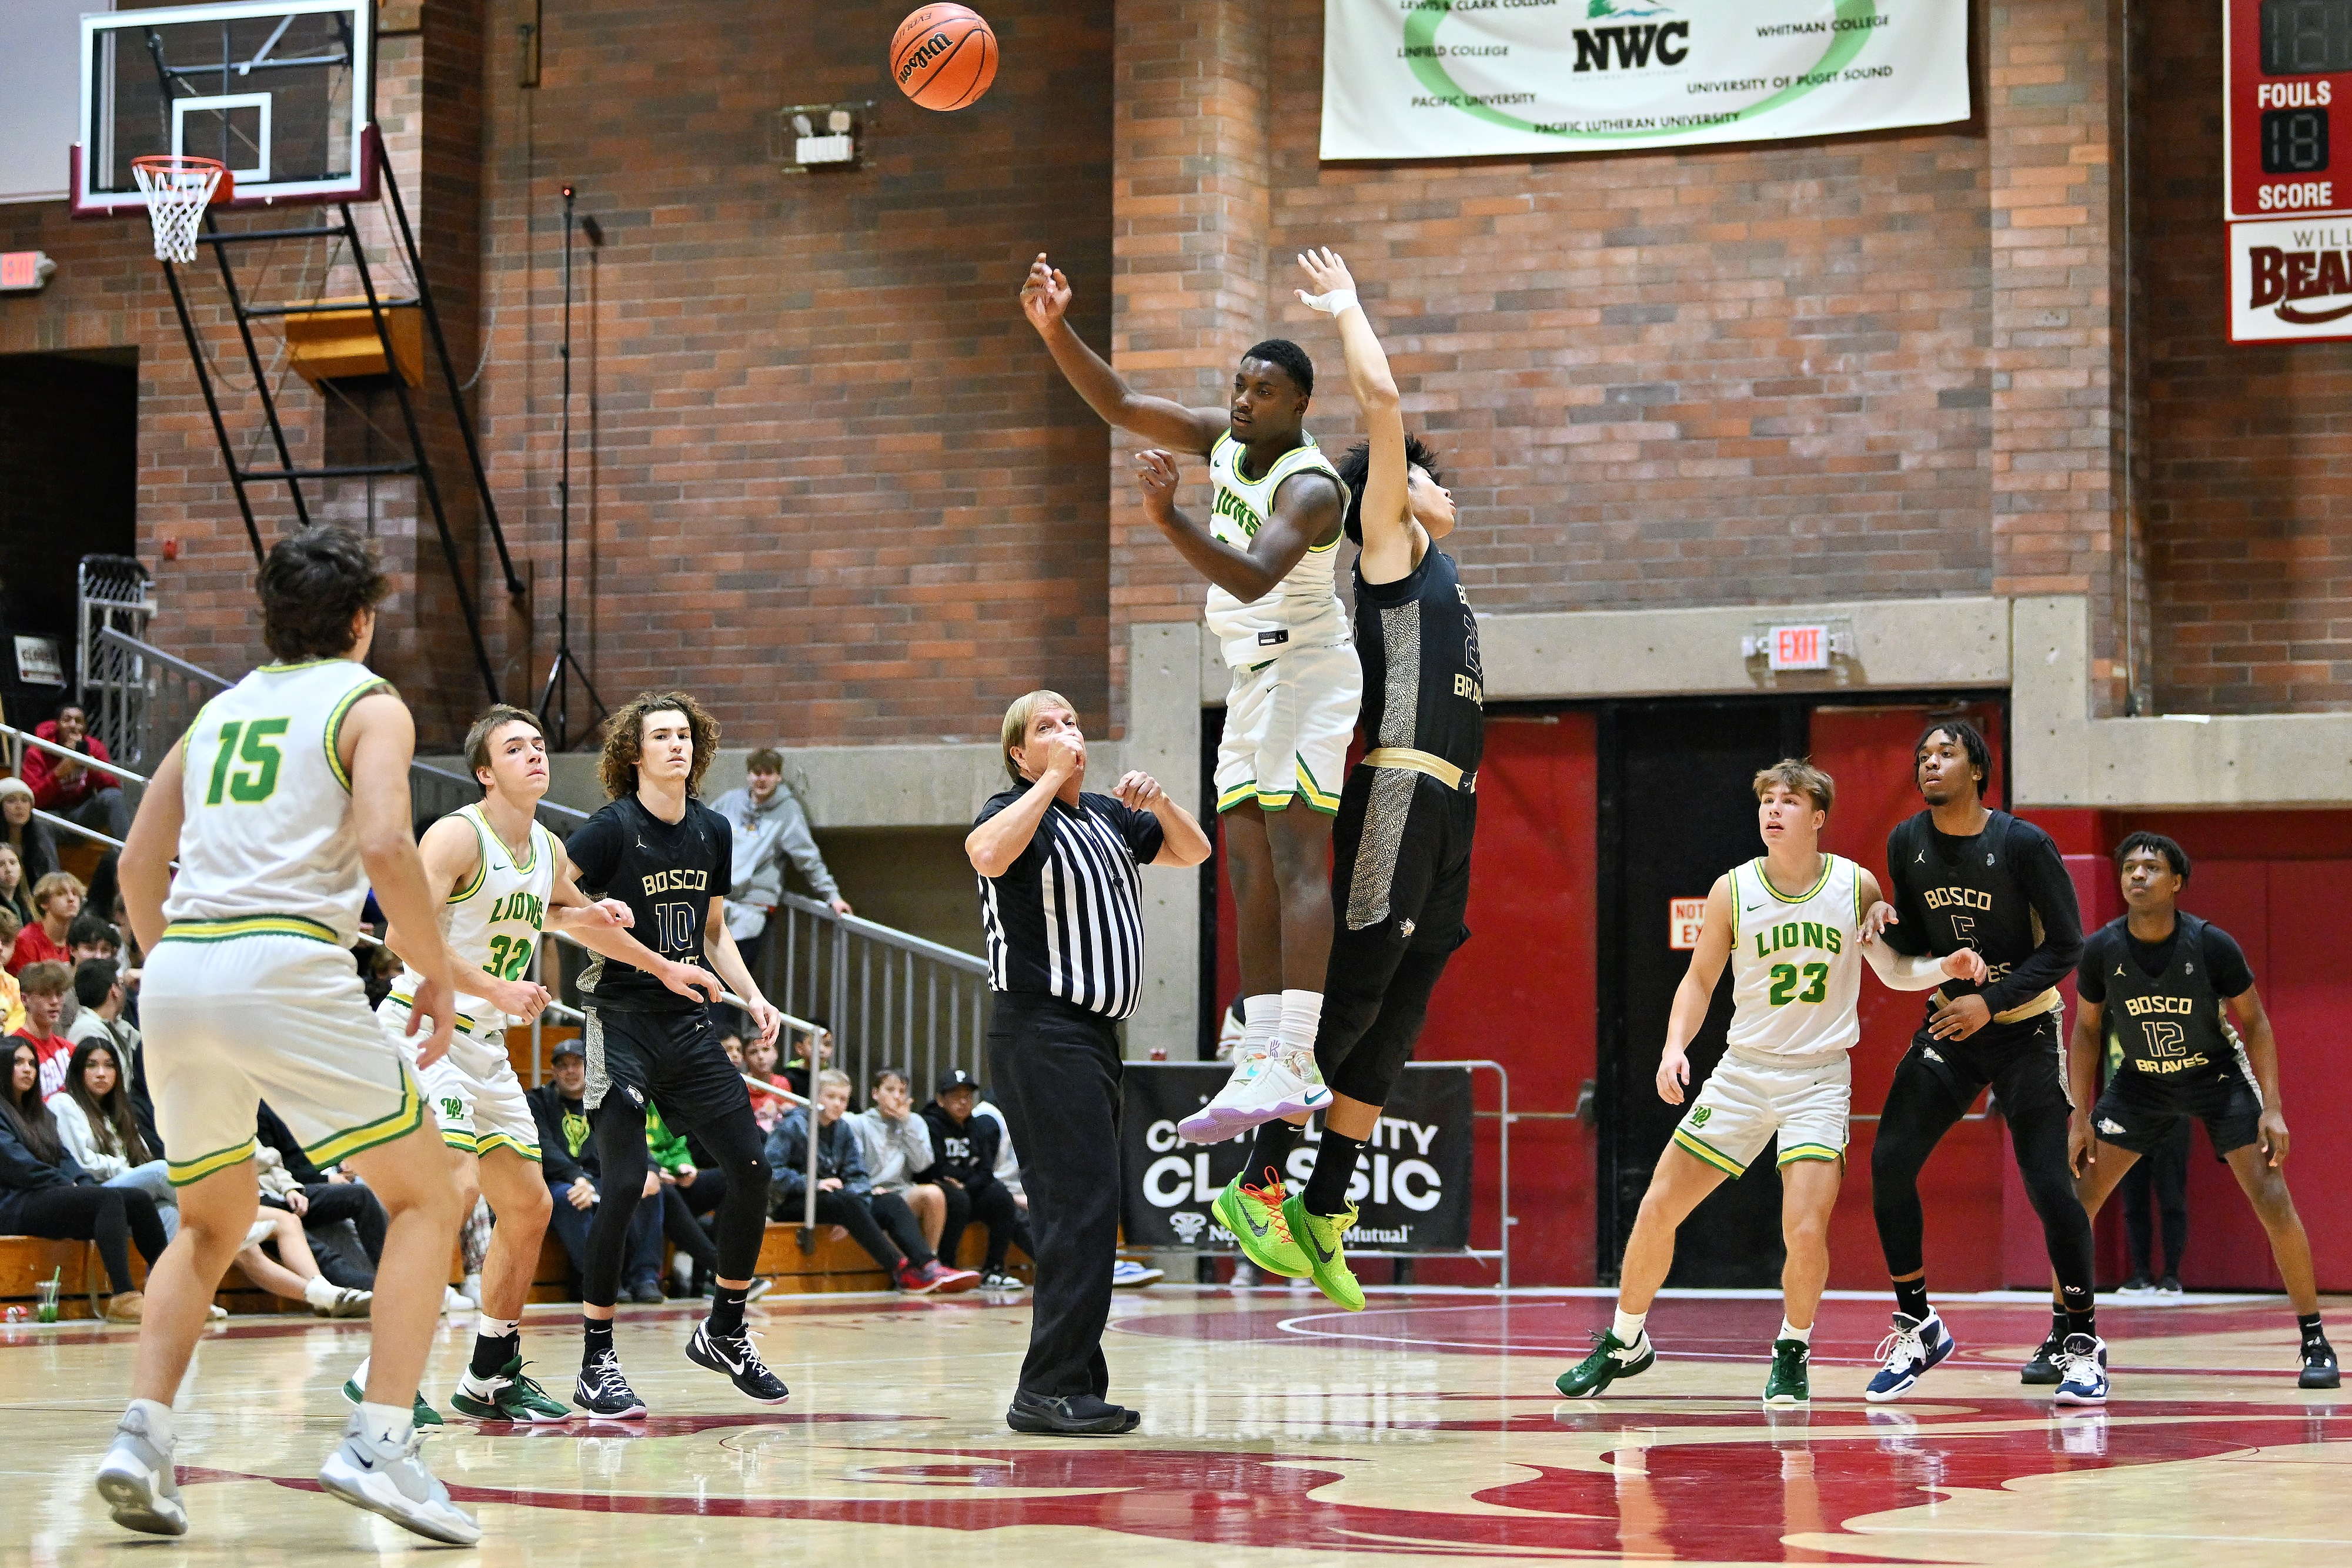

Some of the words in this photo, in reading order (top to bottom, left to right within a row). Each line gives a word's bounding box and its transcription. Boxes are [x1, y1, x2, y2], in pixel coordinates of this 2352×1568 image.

[1456, 0, 1498, 11] CLARK
[1756, 21, 1825, 37] WHITMAN
[1830, 15, 1889, 30] COLLEGE
[898, 32, 954, 84] Wilson
[1396, 45, 1447, 58] LINFIELD
[1451, 45, 1509, 57] COLLEGE
[1572, 20, 1689, 72] NWC
[1687, 78, 1767, 94] UNIVERSITY
[1772, 75, 1790, 89] OF
[1796, 71, 1839, 86] PUGET
[1844, 65, 1893, 81] SOUND
[2258, 80, 2332, 109] FOULS
[1411, 95, 1459, 107] PACIFIC
[1464, 92, 1536, 106] UNIVERSITY
[1534, 121, 1581, 133] PACIFIC
[1587, 117, 1655, 132] LUTHERAN
[1660, 112, 1740, 128] UNIVERSITY
[2258, 181, 2333, 210] SCORE
[2250, 246, 2352, 310] BEA
[1211, 486, 1262, 538] IONS
[1779, 629, 1820, 663] EXIT
[205, 717, 290, 806] 15
[642, 869, 708, 897] BOSCO
[489, 892, 543, 931] LIONS
[1676, 904, 1705, 919] NOT
[1924, 887, 1992, 911] BOSCO
[655, 901, 696, 952] 10
[1755, 921, 1842, 959] LIONS
[1951, 915, 1983, 956] 5
[482, 934, 532, 982] 32
[1770, 962, 1830, 1007] 23
[2125, 996, 2193, 1016] BOSCO
[2141, 1021, 2187, 1057] 12
[2135, 1052, 2210, 1074] BRAVES
